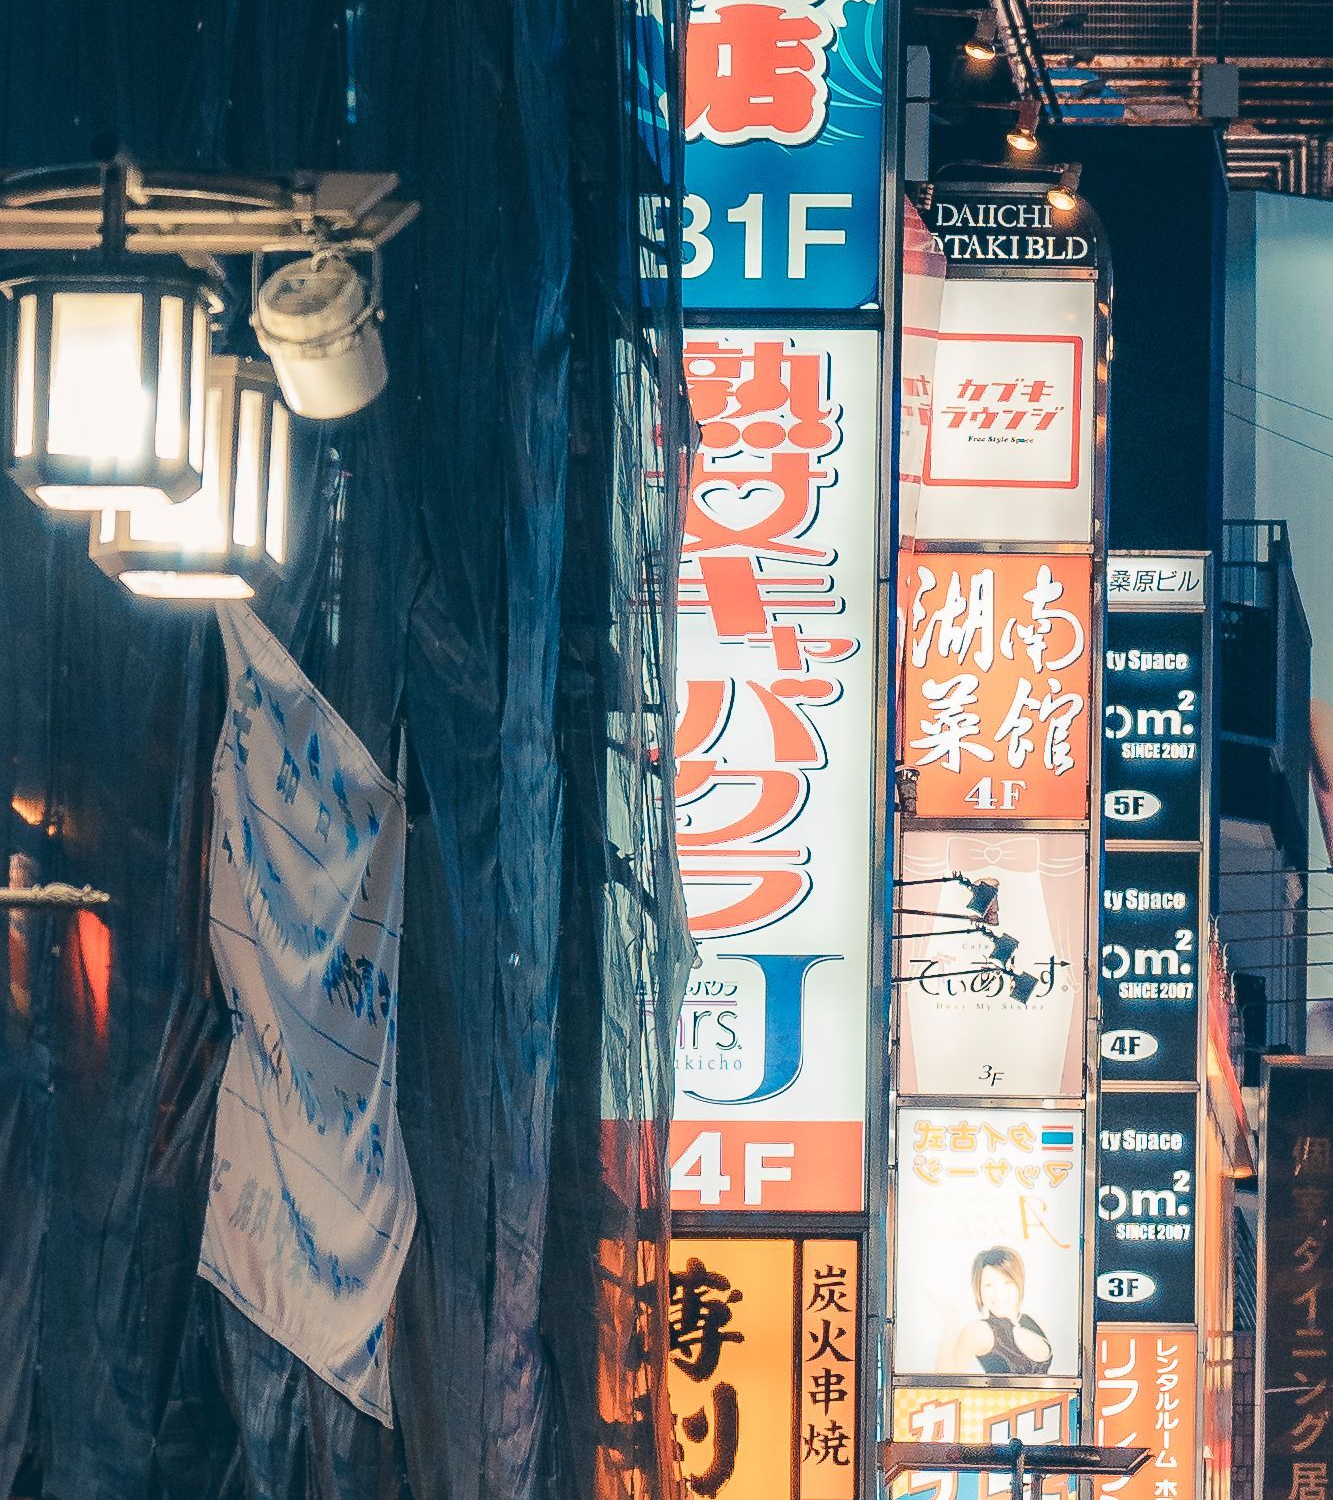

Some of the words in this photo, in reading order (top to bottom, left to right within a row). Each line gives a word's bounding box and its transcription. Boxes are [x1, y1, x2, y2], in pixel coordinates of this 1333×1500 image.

[936, 203, 1053, 228] DAIICHI
[957, 377, 1055, 402] カブキ
[941, 405, 1065, 431] ラウンジ
[968, 436, 986, 444] Free
[989, 436, 1009, 444] Style
[1109, 569, 1200, 593] 桑原ビル
[911, 567, 1086, 674] 湖南
[1126, 650, 1189, 671] Space
[909, 680, 1086, 776] 菜館
[1121, 742, 1160, 760] SINCE
[1161, 742, 1196, 759] 2007
[964, 776, 1026, 811] 4F
[1113, 796, 1145, 816] 5F
[1125, 888, 1186, 909] Space
[1119, 982, 1158, 999] SINCE
[1159, 982, 1194, 999] 2007
[1110, 1036, 1141, 1056] 4F
[1123, 1130, 1184, 1151] Space
[671, 1131, 795, 1206] 4F
[1116, 1224, 1155, 1241] SINCE
[1156, 1224, 1191, 1241] 2007
[1108, 1277, 1141, 1298] 3F
[803, 1265, 855, 1467] 炭火串焼
[1154, 1338, 1180, 1468] レンタルルーム
